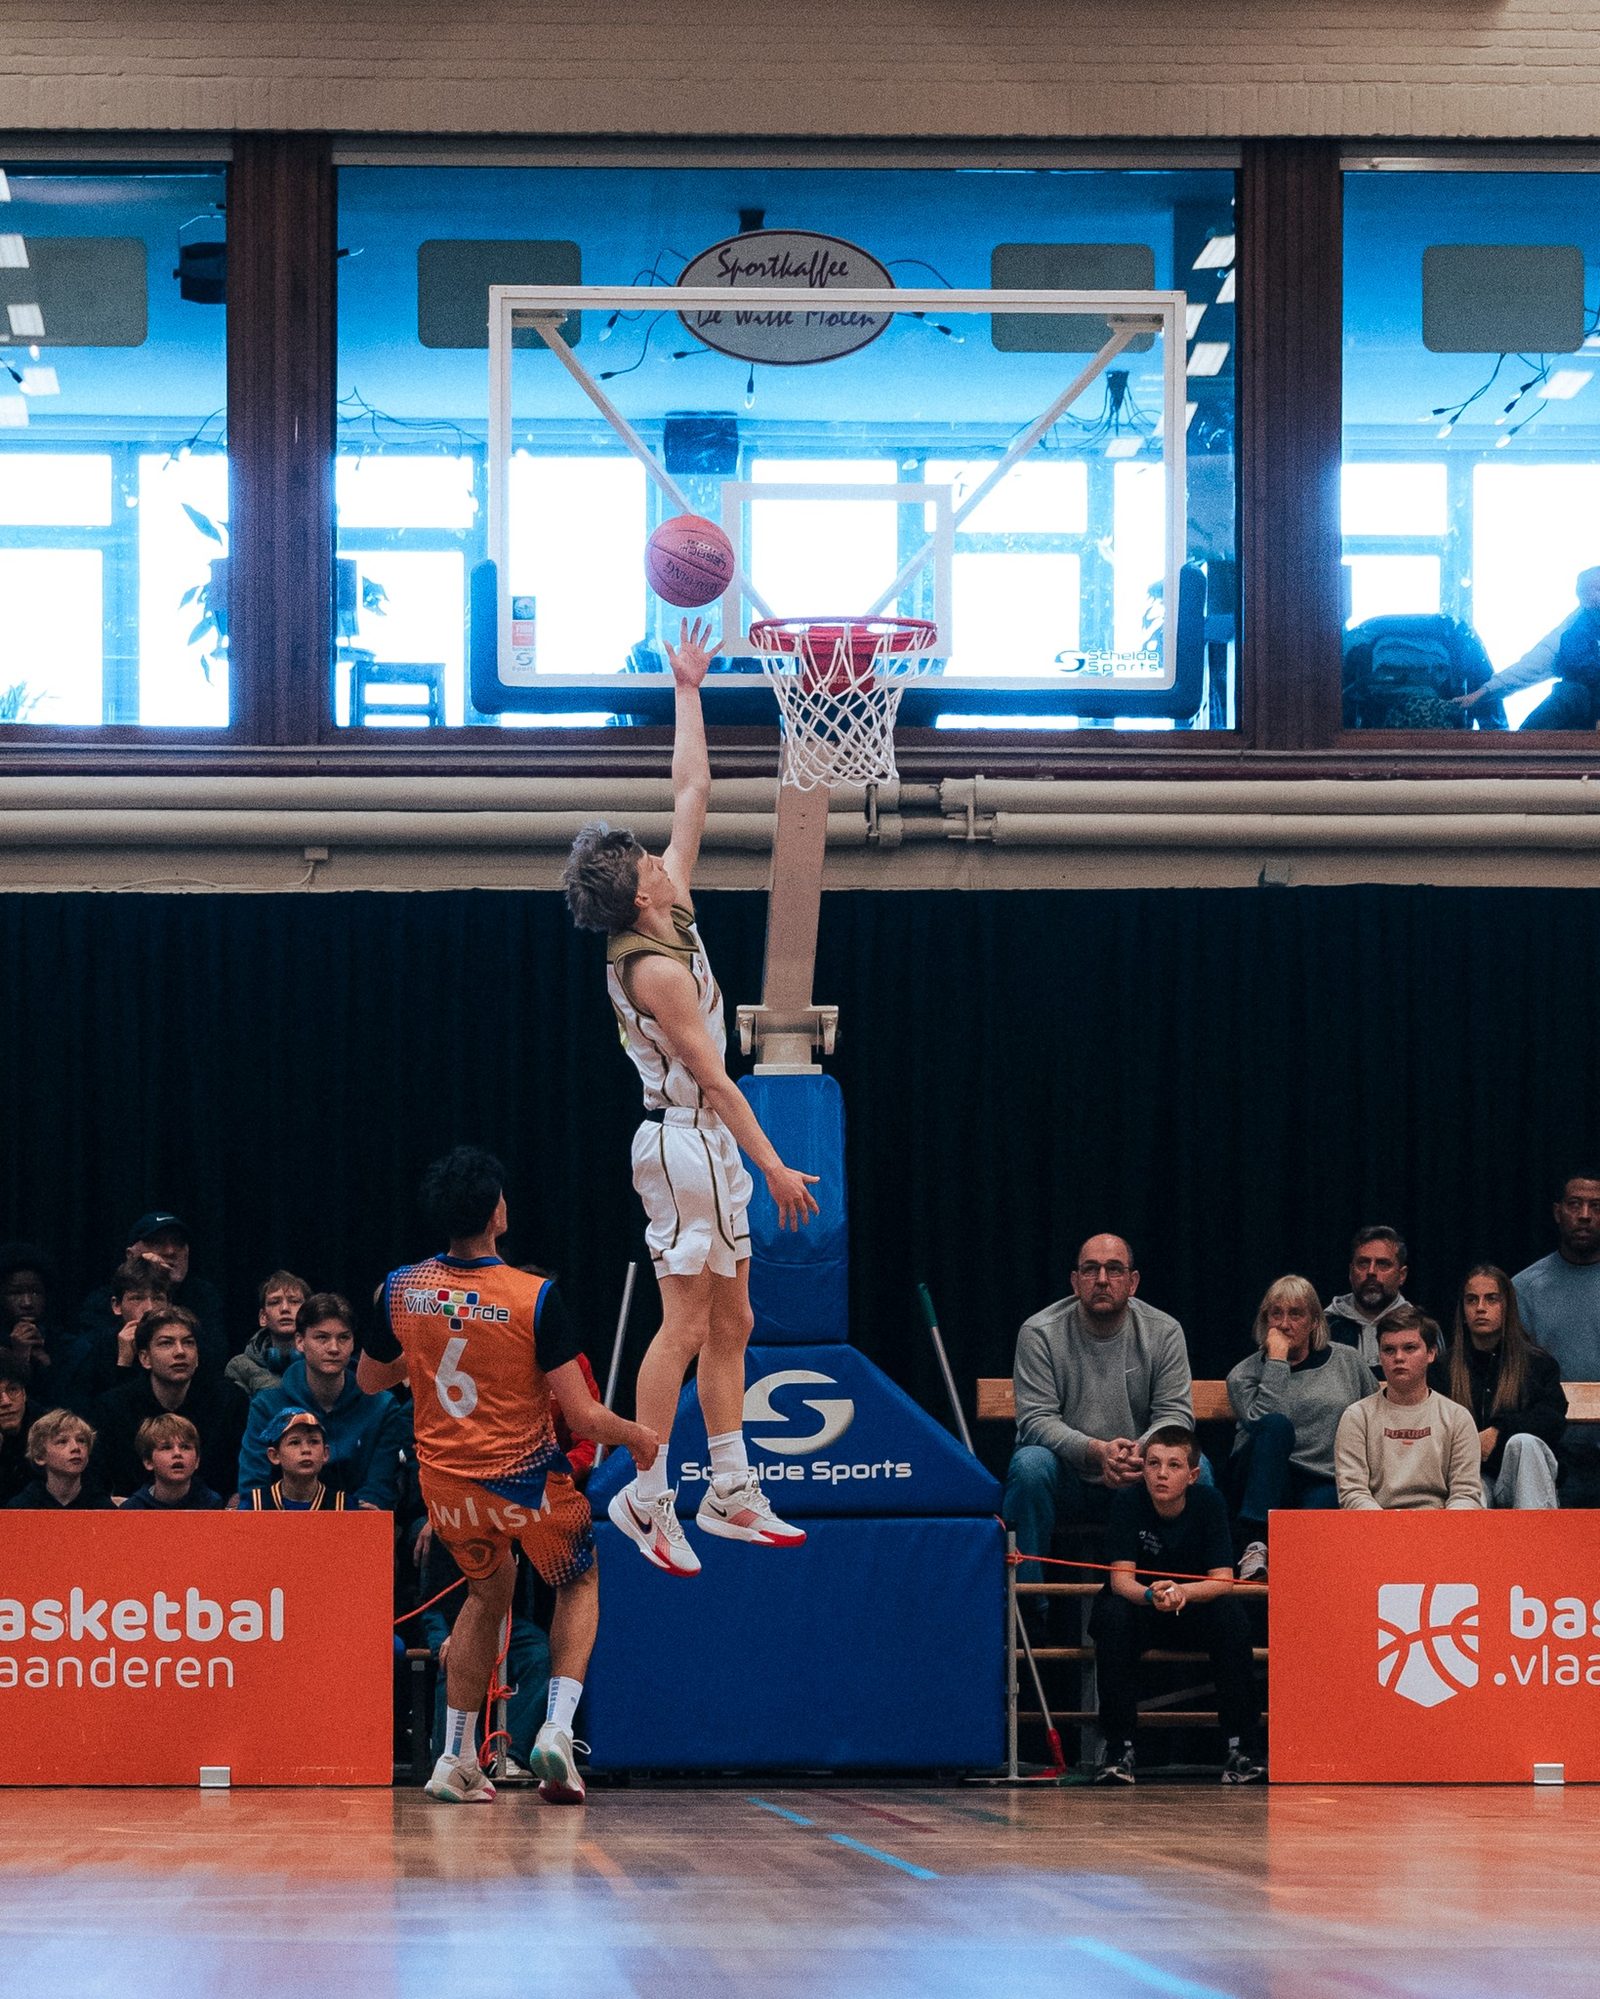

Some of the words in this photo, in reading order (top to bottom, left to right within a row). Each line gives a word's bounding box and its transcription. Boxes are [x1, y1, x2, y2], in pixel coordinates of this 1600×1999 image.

[716, 247, 850, 289] Sportkaffee
[697, 310, 722, 328] De
[805, 311, 876, 328] Molen
[1088, 650, 1159, 661] Schelde
[1088, 661, 1159, 674] Sports
[435, 1337, 478, 1419] 6
[681, 1462, 805, 1481] Sclde
[812, 1460, 912, 1485] Sports
[1510, 1585, 1600, 1639] ba
